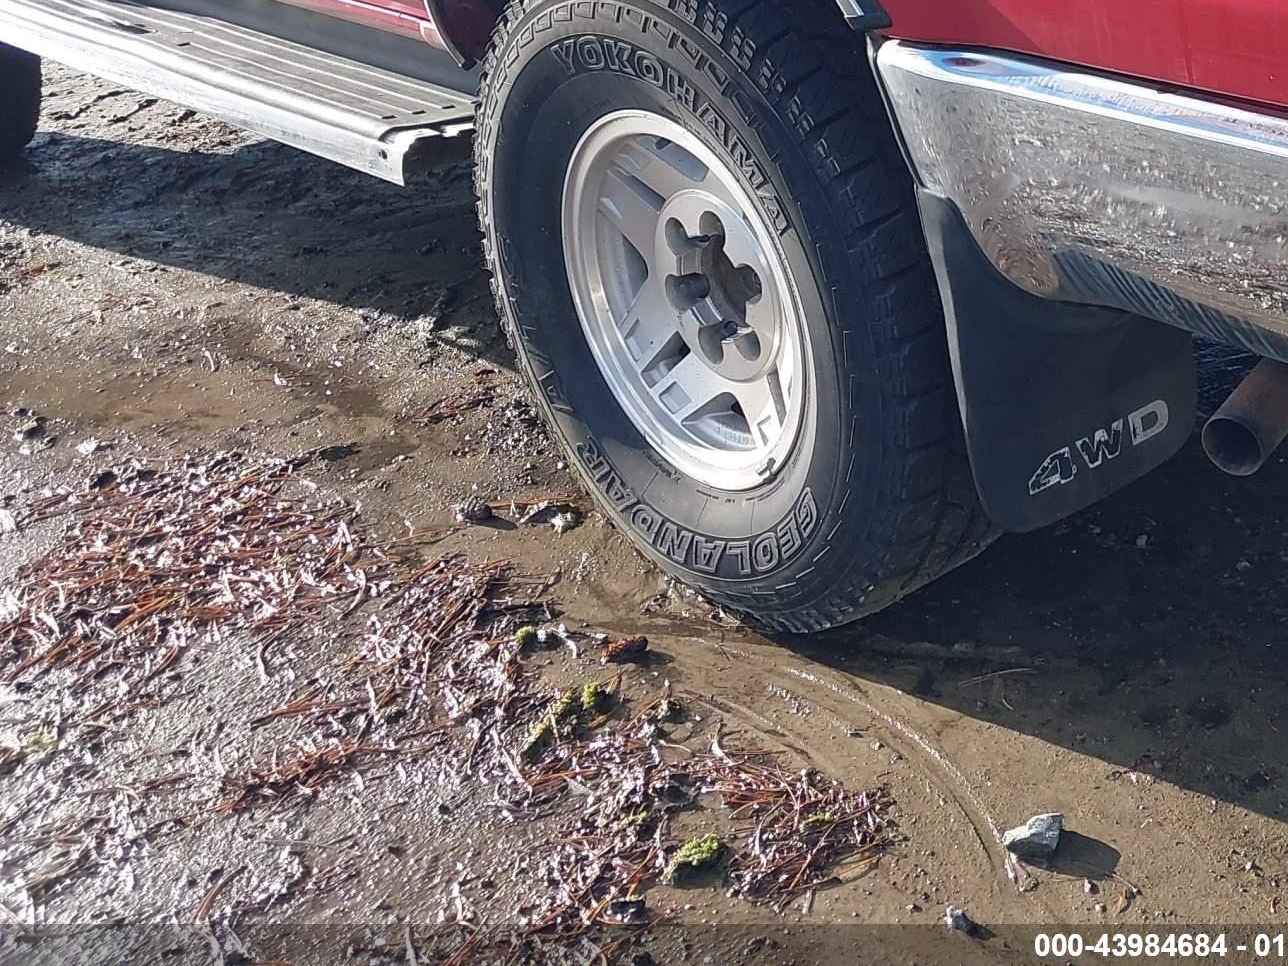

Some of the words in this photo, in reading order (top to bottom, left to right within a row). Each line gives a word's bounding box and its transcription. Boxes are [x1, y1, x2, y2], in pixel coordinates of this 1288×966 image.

[551, 36, 790, 237] YOKOHAMA
[575, 434, 818, 575] GEOLANDAR
[1028, 400, 1169, 495] 4WD
